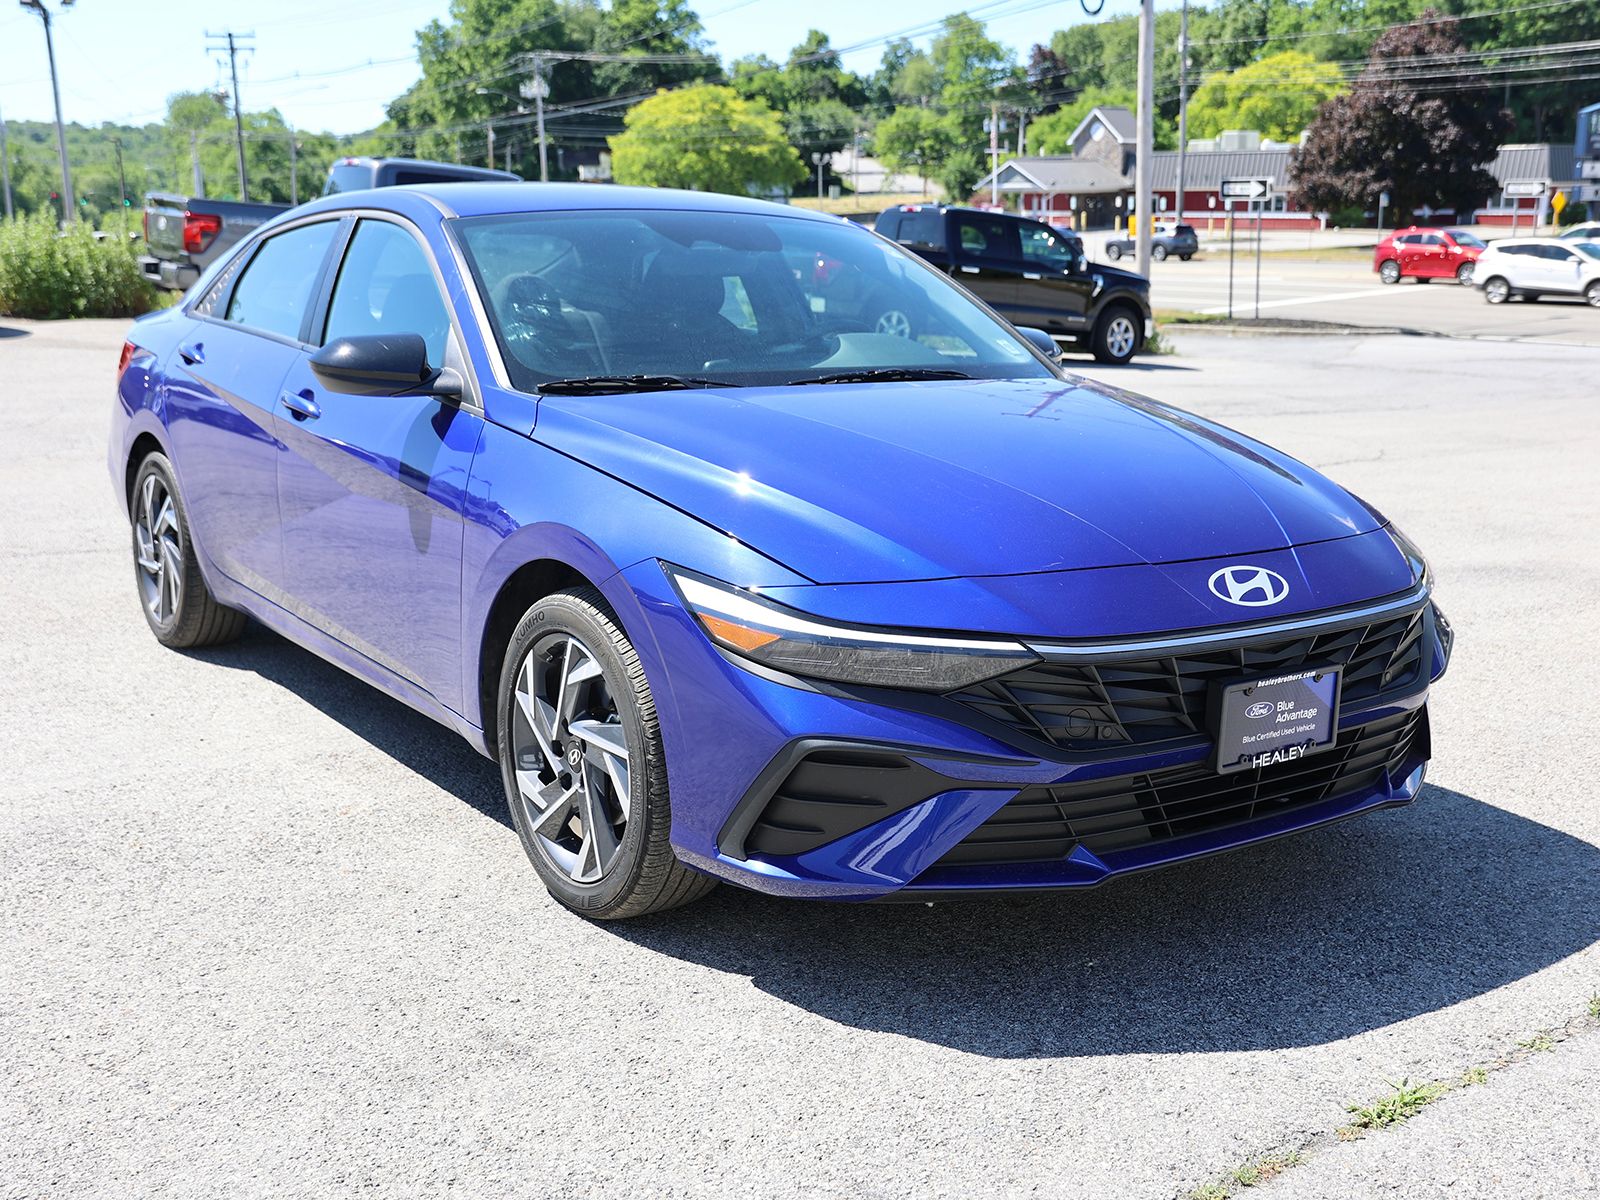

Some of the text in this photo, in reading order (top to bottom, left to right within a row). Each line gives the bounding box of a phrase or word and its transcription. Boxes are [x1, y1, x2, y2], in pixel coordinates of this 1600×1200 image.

[515, 611, 545, 644] KUMHO
[1257, 670, 1316, 687] healeybrothers.com
[1250, 704, 1270, 717] Ford
[1277, 700, 1295, 712] Blue
[1275, 708, 1318, 723] Advantage
[1242, 723, 1316, 744] Blue Certified Used Vehicle
[1252, 744, 1307, 768] HEALEY
